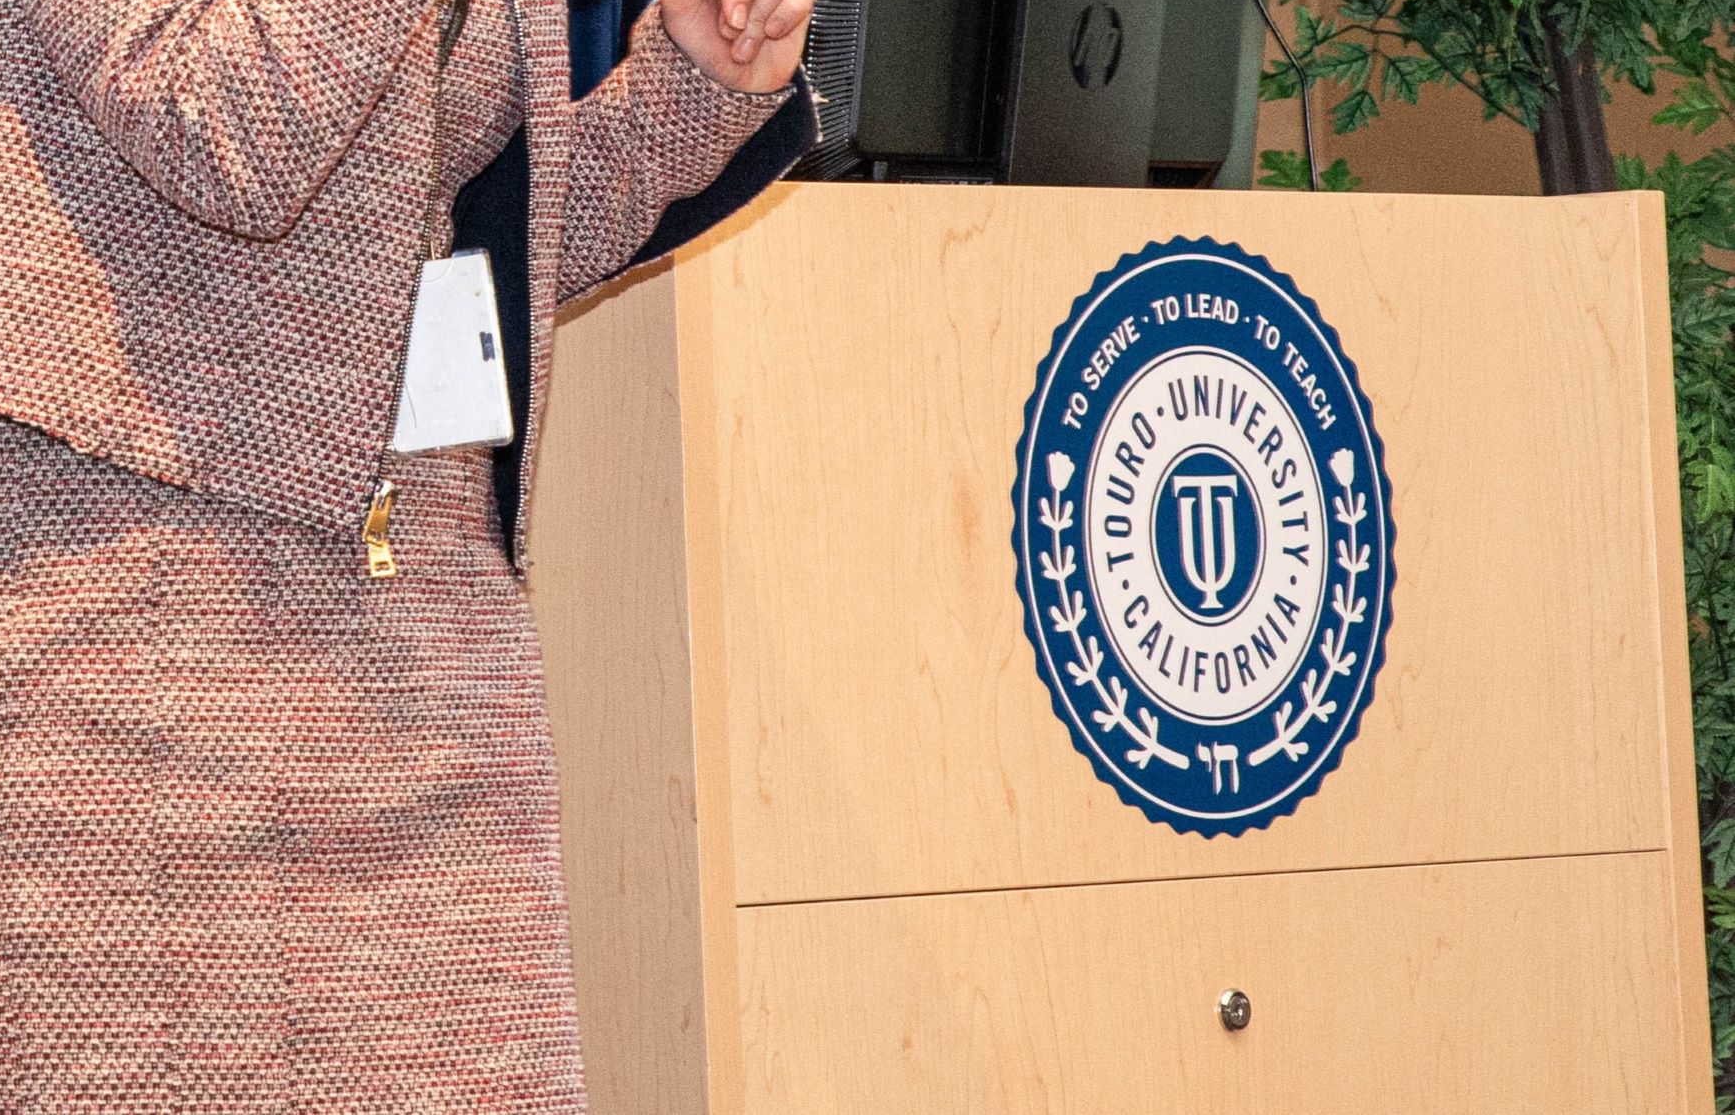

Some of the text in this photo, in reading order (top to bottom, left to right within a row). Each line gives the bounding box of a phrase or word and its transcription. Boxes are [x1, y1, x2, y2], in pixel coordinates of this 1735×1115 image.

[1062, 293, 1337, 430] TO SERVE TO LEAD TO TEACH
[1104, 375, 1310, 572] TOURO UNIVERSITY
[1124, 593, 1301, 694] CALIFORNIA
[1197, 741, 1240, 795] חי
